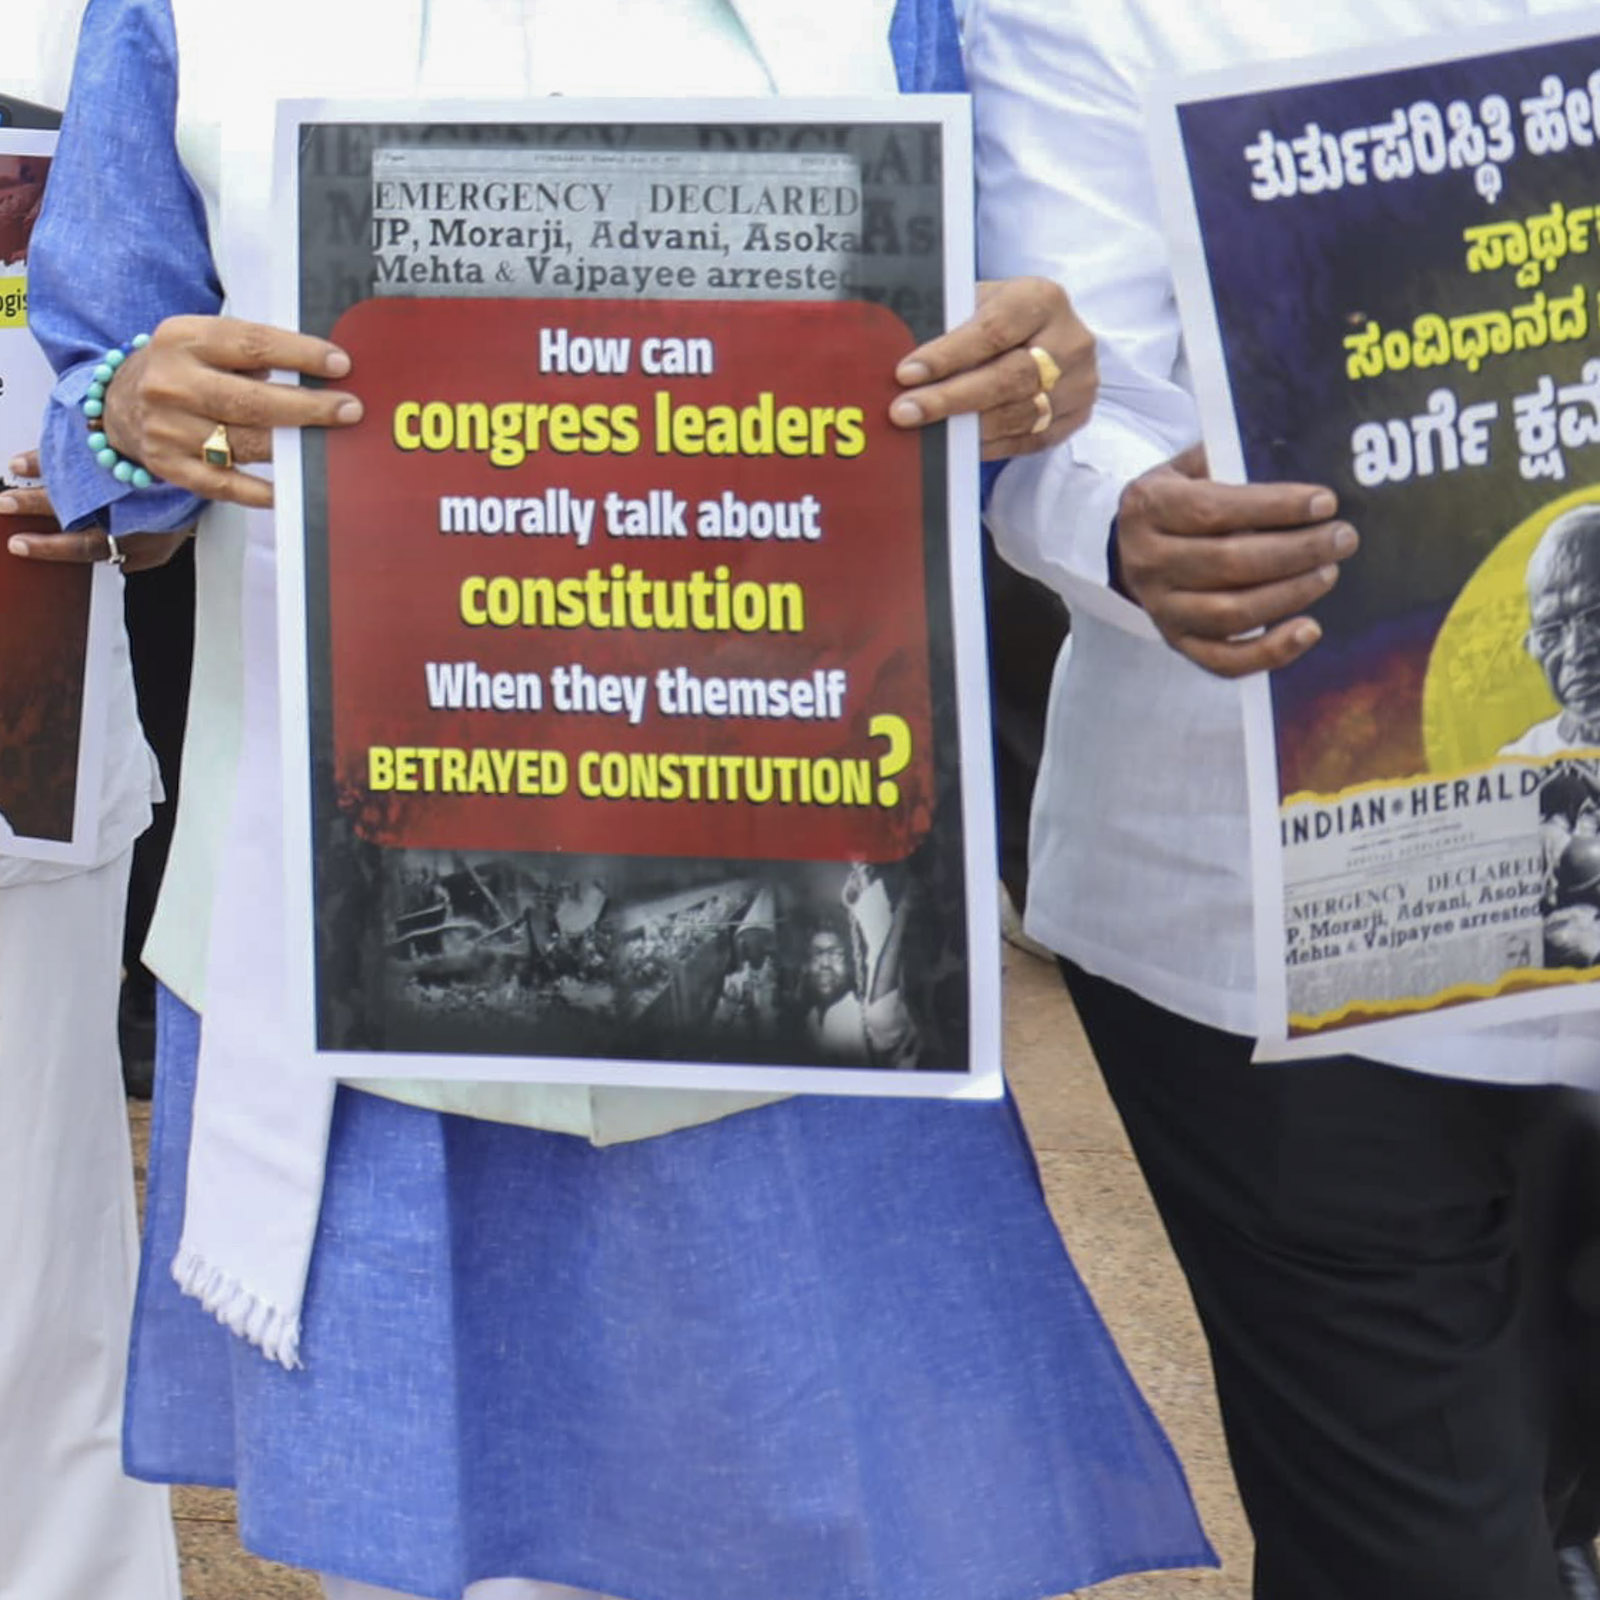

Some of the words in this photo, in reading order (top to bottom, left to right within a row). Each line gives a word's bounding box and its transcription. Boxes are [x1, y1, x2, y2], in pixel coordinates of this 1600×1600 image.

[1244, 94, 1515, 204] ತುರ್ತುಪರಿಸ್ಥಿತಿ
[373, 182, 613, 212] EMERGENCY
[650, 184, 859, 216] DECLARED
[372, 217, 420, 252] JP,
[428, 218, 573, 257] Morarji,
[589, 220, 730, 257] Advani,
[742, 223, 859, 252] Asoka
[1463, 201, 1600, 289] ಸ್ವಾರ್ಥ
[373, 254, 484, 284] Mehta
[494, 259, 515, 282] &
[526, 255, 696, 293] Vajpayee
[539, 328, 631, 376] How
[640, 337, 714, 376] can
[1343, 284, 1588, 380] ಸಂವಿಧಾನದ
[393, 401, 640, 468] congress
[654, 391, 867, 457] leaders
[1351, 387, 1498, 487] ಖರ್ಗೆ
[440, 488, 596, 547] morally
[604, 490, 689, 539] talk
[696, 491, 822, 541] about
[460, 563, 805, 632] constitution
[425, 662, 542, 710] When
[551, 664, 646, 724] they
[656, 667, 846, 719] themself
[368, 746, 568, 796] BETRAYED
[1281, 796, 1386, 848] INDIAN
[1411, 769, 1540, 818] HERALD
[1363, 920, 1455, 950] Vajpayee
